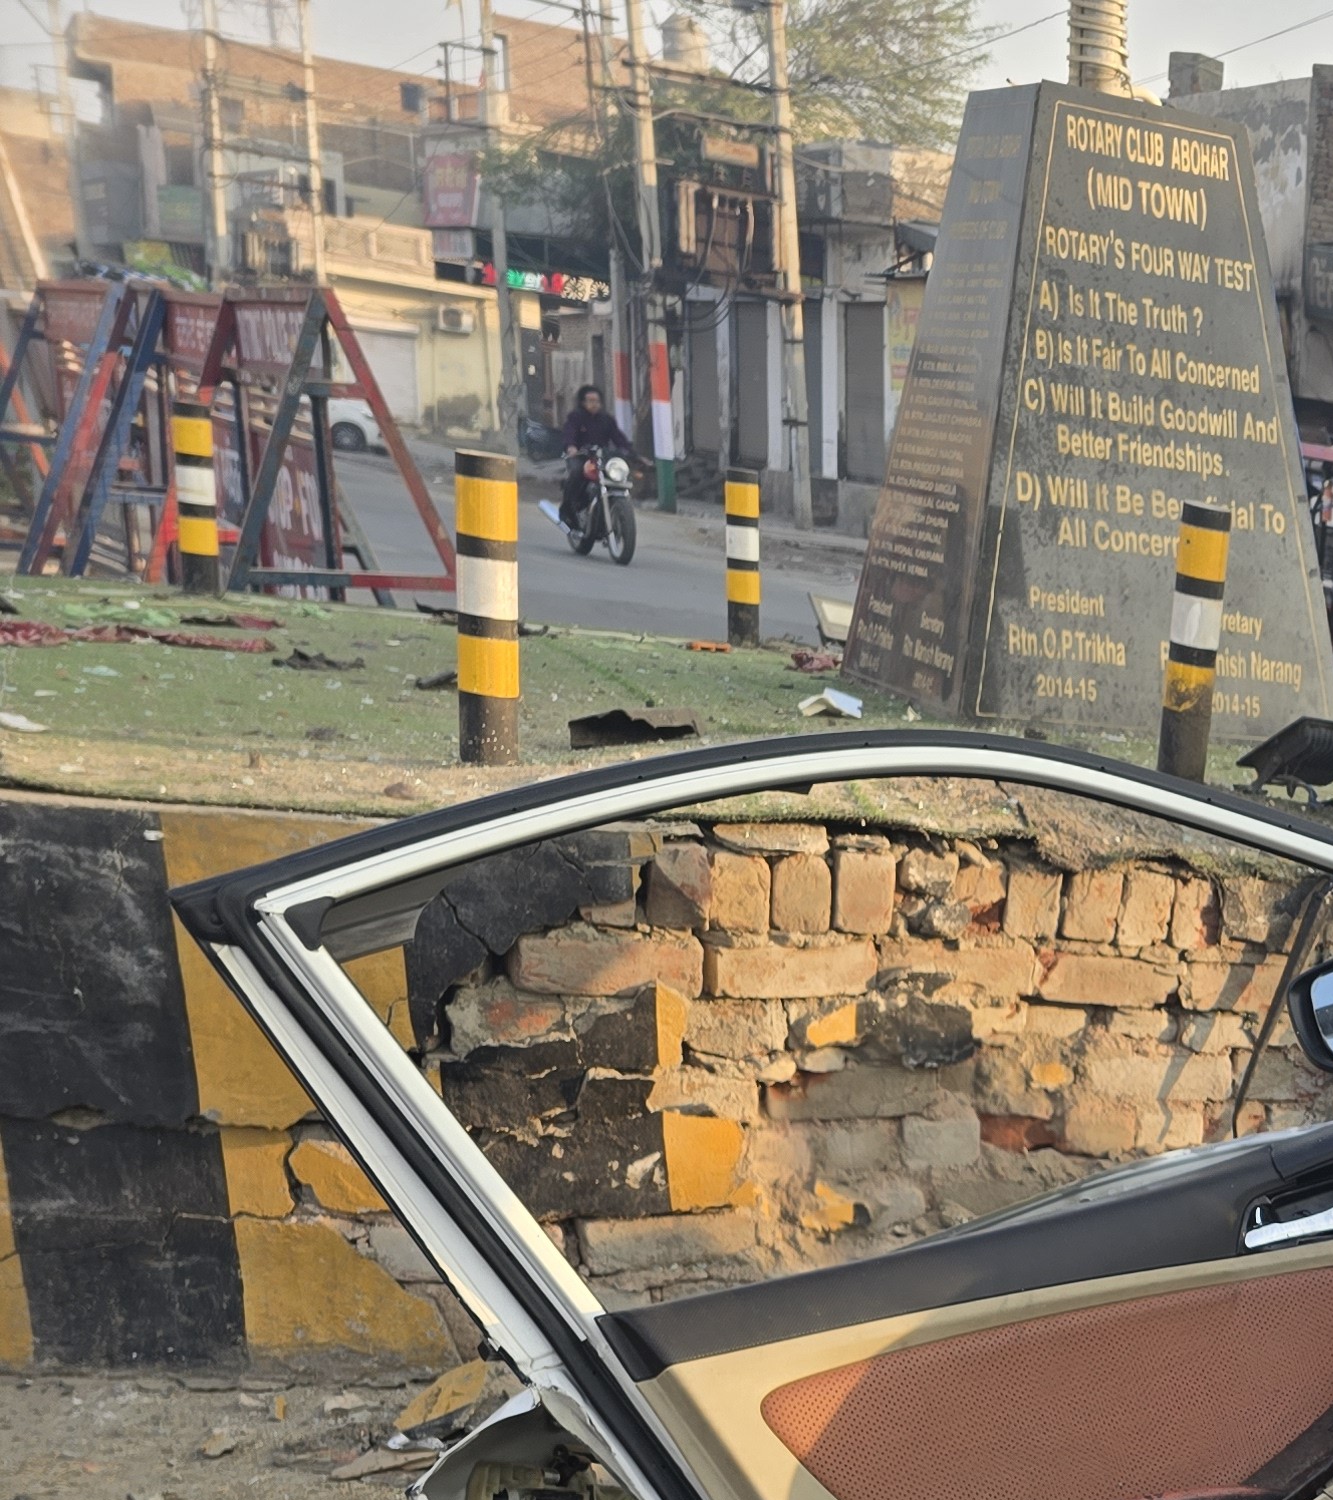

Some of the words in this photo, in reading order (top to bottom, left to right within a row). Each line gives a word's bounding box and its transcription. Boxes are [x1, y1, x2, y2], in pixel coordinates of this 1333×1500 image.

[1067, 114, 1122, 159] ROTARY
[1127, 126, 1165, 168] CLUB
[1171, 137, 1230, 182] ABOHAR
[1088, 166, 1133, 212] (MID
[1138, 181, 1208, 232] TOWN)
[1045, 225, 1126, 270] ROTARY'S
[1131, 241, 1174, 279] FOUR
[1178, 250, 1211, 284] WAY
[1215, 258, 1253, 292] TEST
[1039, 280, 1060, 321] A)
[1069, 285, 1085, 318] Is
[1089, 288, 1101, 321] It
[1104, 291, 1138, 327] The
[1142, 298, 1188, 335] Truth
[1035, 329, 1054, 370] B)
[1058, 333, 1073, 366] Is
[1077, 335, 1089, 367] It
[1092, 338, 1122, 372] Fair
[1127, 344, 1146, 377] To
[1150, 348, 1172, 380] All
[1176, 351, 1260, 395] Concerned
[1024, 378, 1046, 416] C)
[1050, 382, 1085, 417] Will
[1090, 388, 1103, 420] It
[1108, 392, 1155, 427] Build
[1160, 399, 1238, 439] Goodwill
[1243, 412, 1278, 445] And
[1057, 423, 1113, 462] Better
[1015, 470, 1041, 512] D)
[1047, 474, 1088, 509] Will
[1095, 478, 1109, 512] It
[1115, 485, 1144, 516] Be
[1260, 504, 1286, 535] To
[1058, 516, 1087, 548] All
[1093, 520, 1180, 559] Concer
[1030, 585, 1105, 618] President
[1221, 610, 1263, 641] retary
[1036, 674, 1097, 702] 2014-15
[1216, 648, 1247, 680] nish
[1251, 651, 1302, 692] Narang
